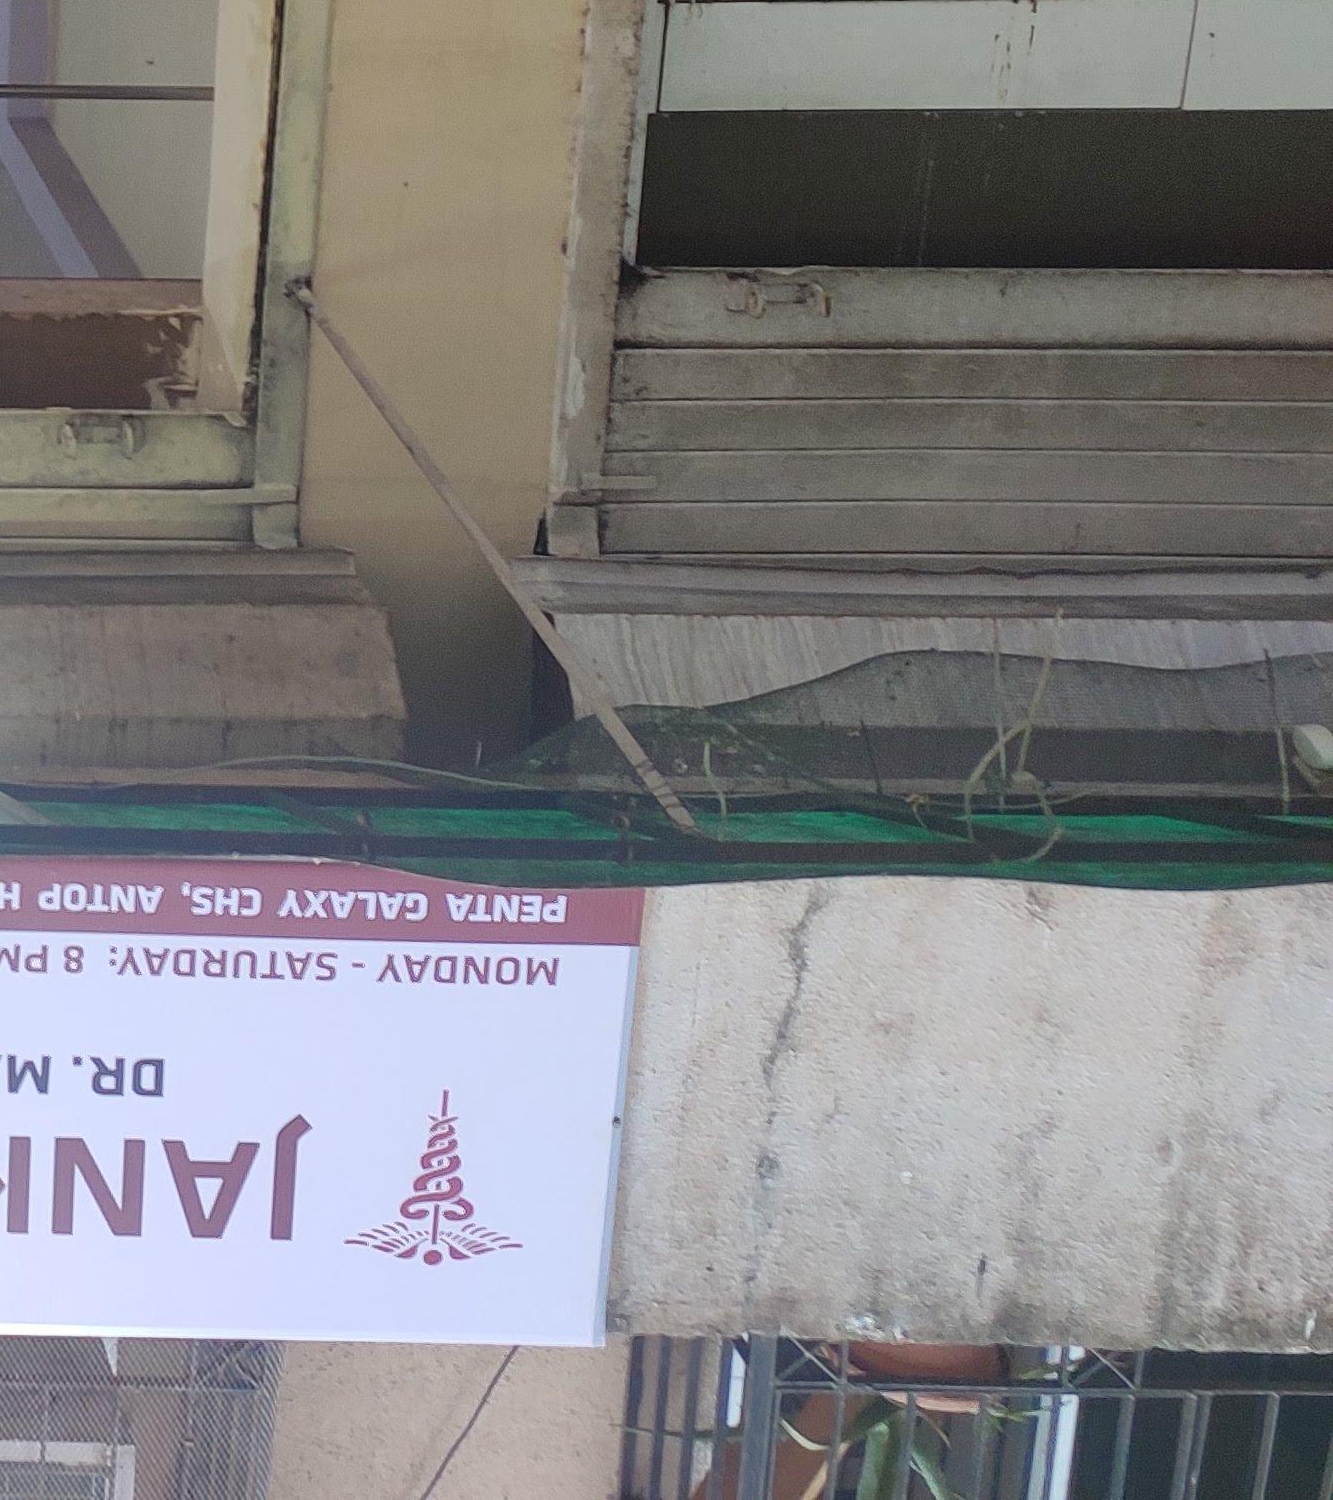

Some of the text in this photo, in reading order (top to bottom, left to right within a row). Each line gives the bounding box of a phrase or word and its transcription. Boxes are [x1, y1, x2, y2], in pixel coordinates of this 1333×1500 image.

[37, 882, 165, 915] ANTOP
[181, 879, 263, 918] CHS,
[277, 886, 430, 921] GALAXY
[444, 890, 569, 924] PENTA
[63, 944, 85, 975] 8
[108, 945, 339, 983] SATURDAY:
[376, 953, 561, 987] MONDAY
[71, 1055, 166, 1099] DR.
